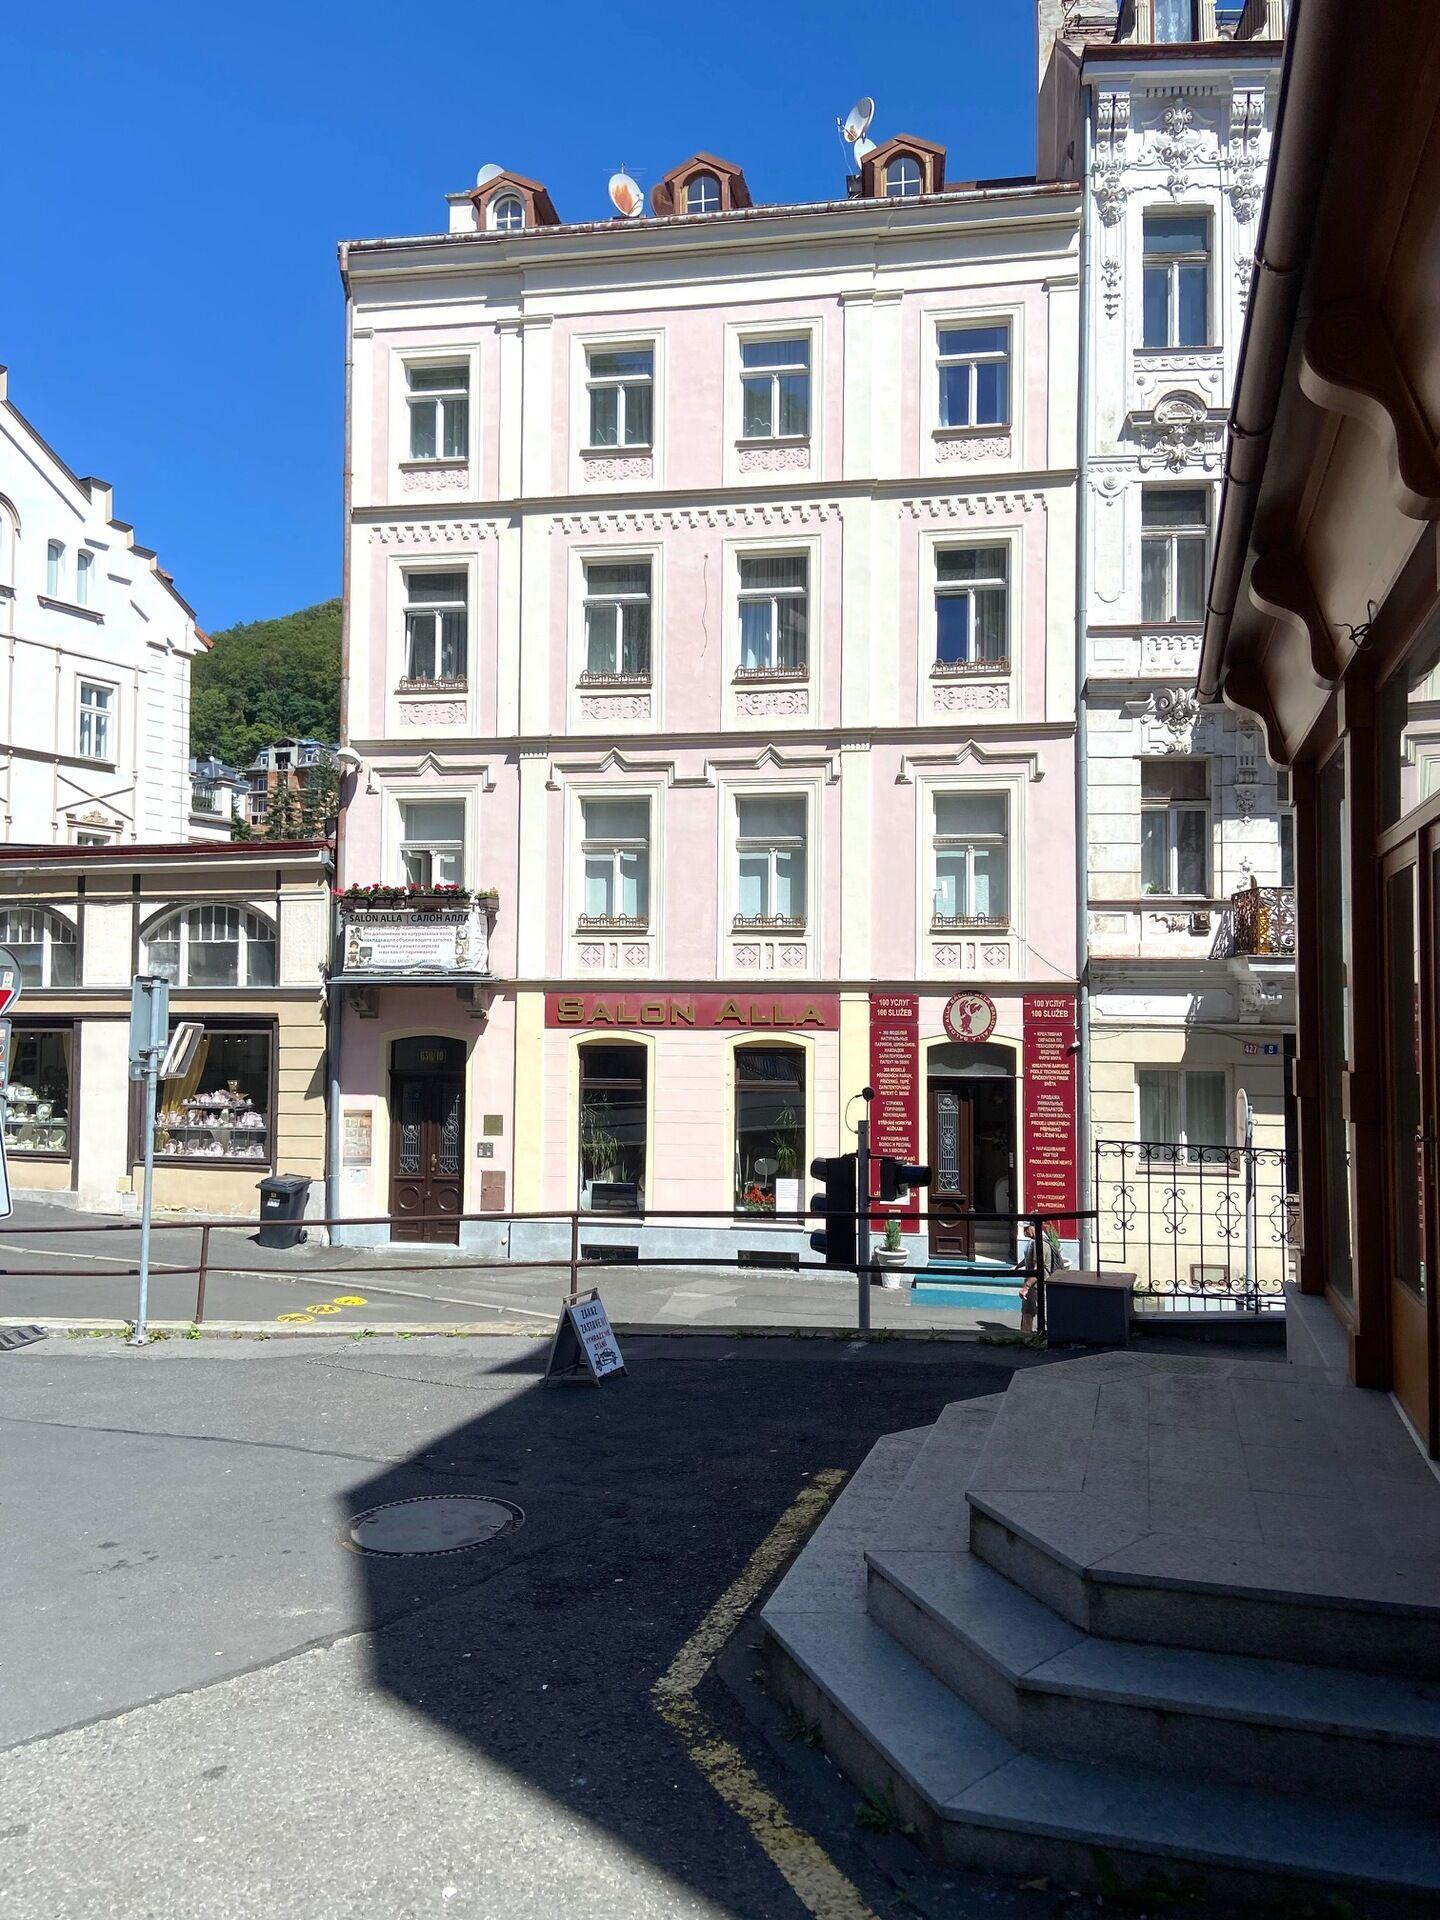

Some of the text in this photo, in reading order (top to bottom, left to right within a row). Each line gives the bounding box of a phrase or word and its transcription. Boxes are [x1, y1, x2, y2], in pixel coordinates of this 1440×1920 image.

[557, 997, 825, 1027] SALON ALLA
[888, 1008, 912, 1016] SLUŽEB
[1043, 1009, 1068, 1017] SLUŽEB
[1244, 1045, 1257, 1053] 427
[581, 1306, 598, 1319] ZÁKAZ
